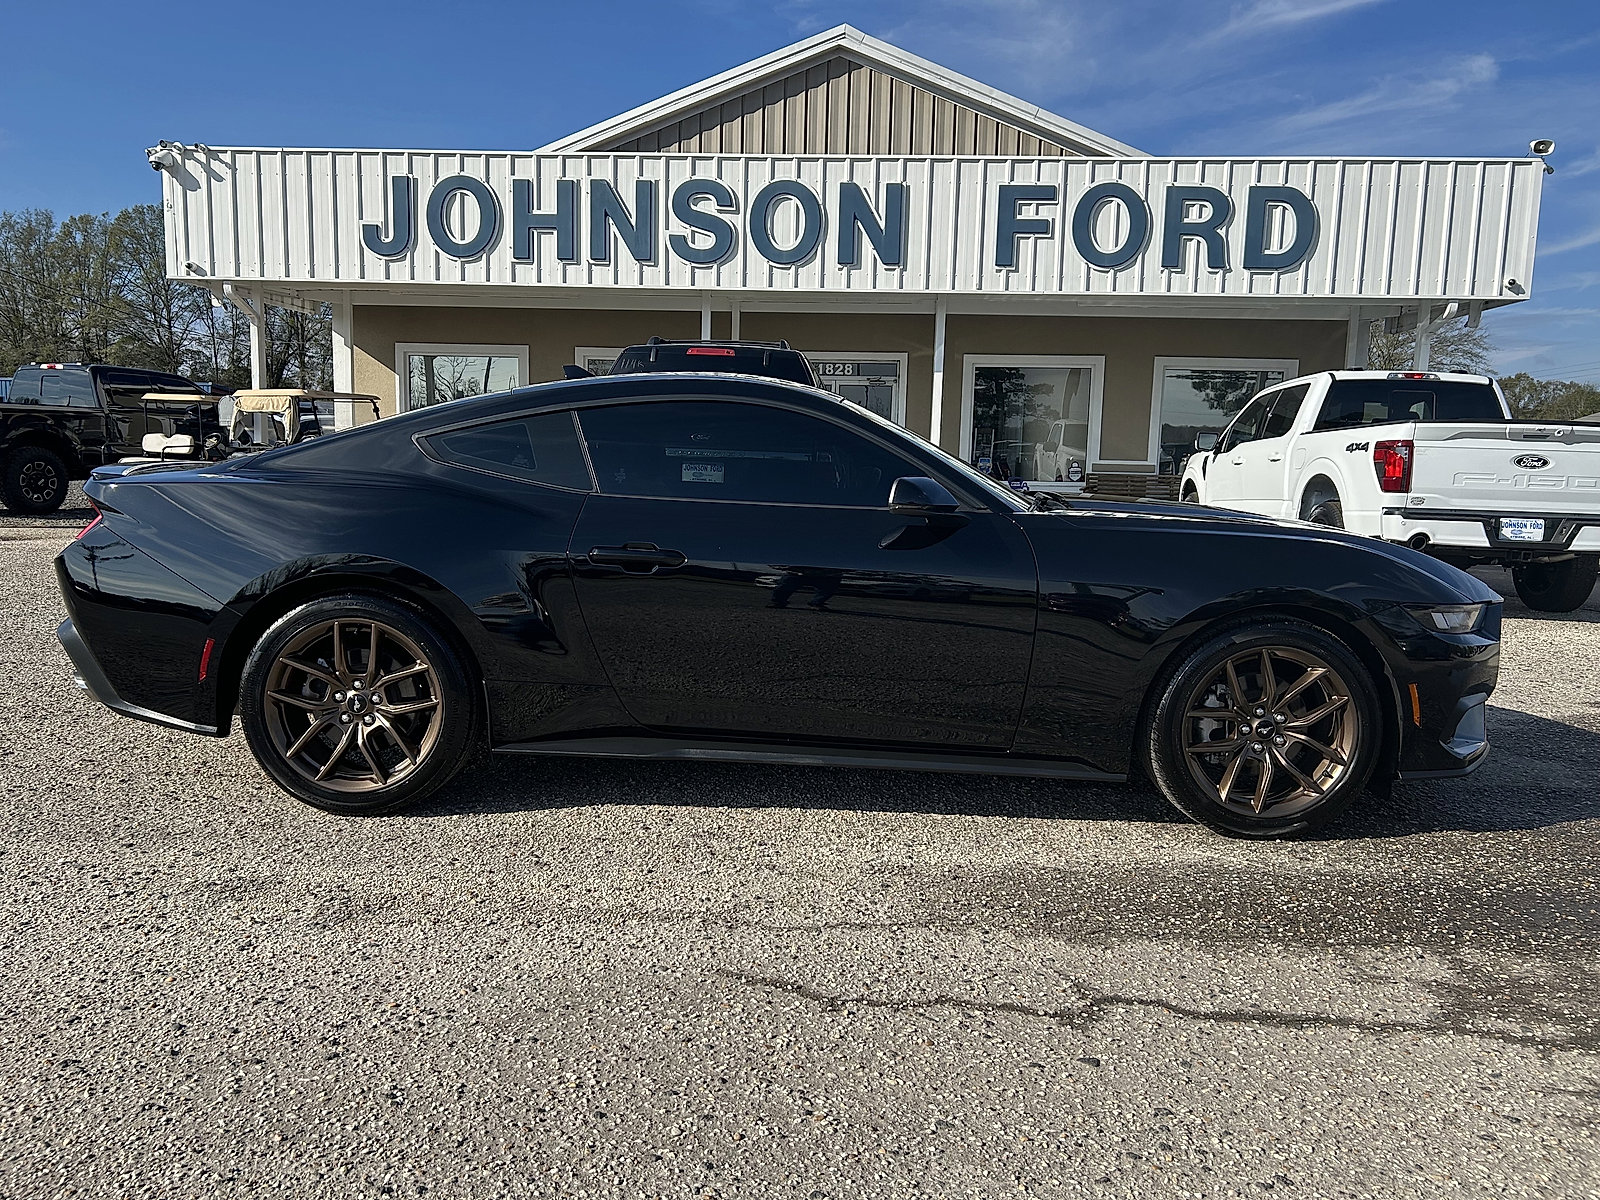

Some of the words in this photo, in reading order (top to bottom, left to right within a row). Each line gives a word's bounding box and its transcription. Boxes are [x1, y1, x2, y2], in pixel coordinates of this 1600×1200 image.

[361, 174, 903, 267] JOHNSON
[995, 181, 1317, 271] FORD
[819, 363, 853, 375] 1828
[683, 464, 707, 472] JOHNSON
[1452, 471, 1600, 491] F-150
